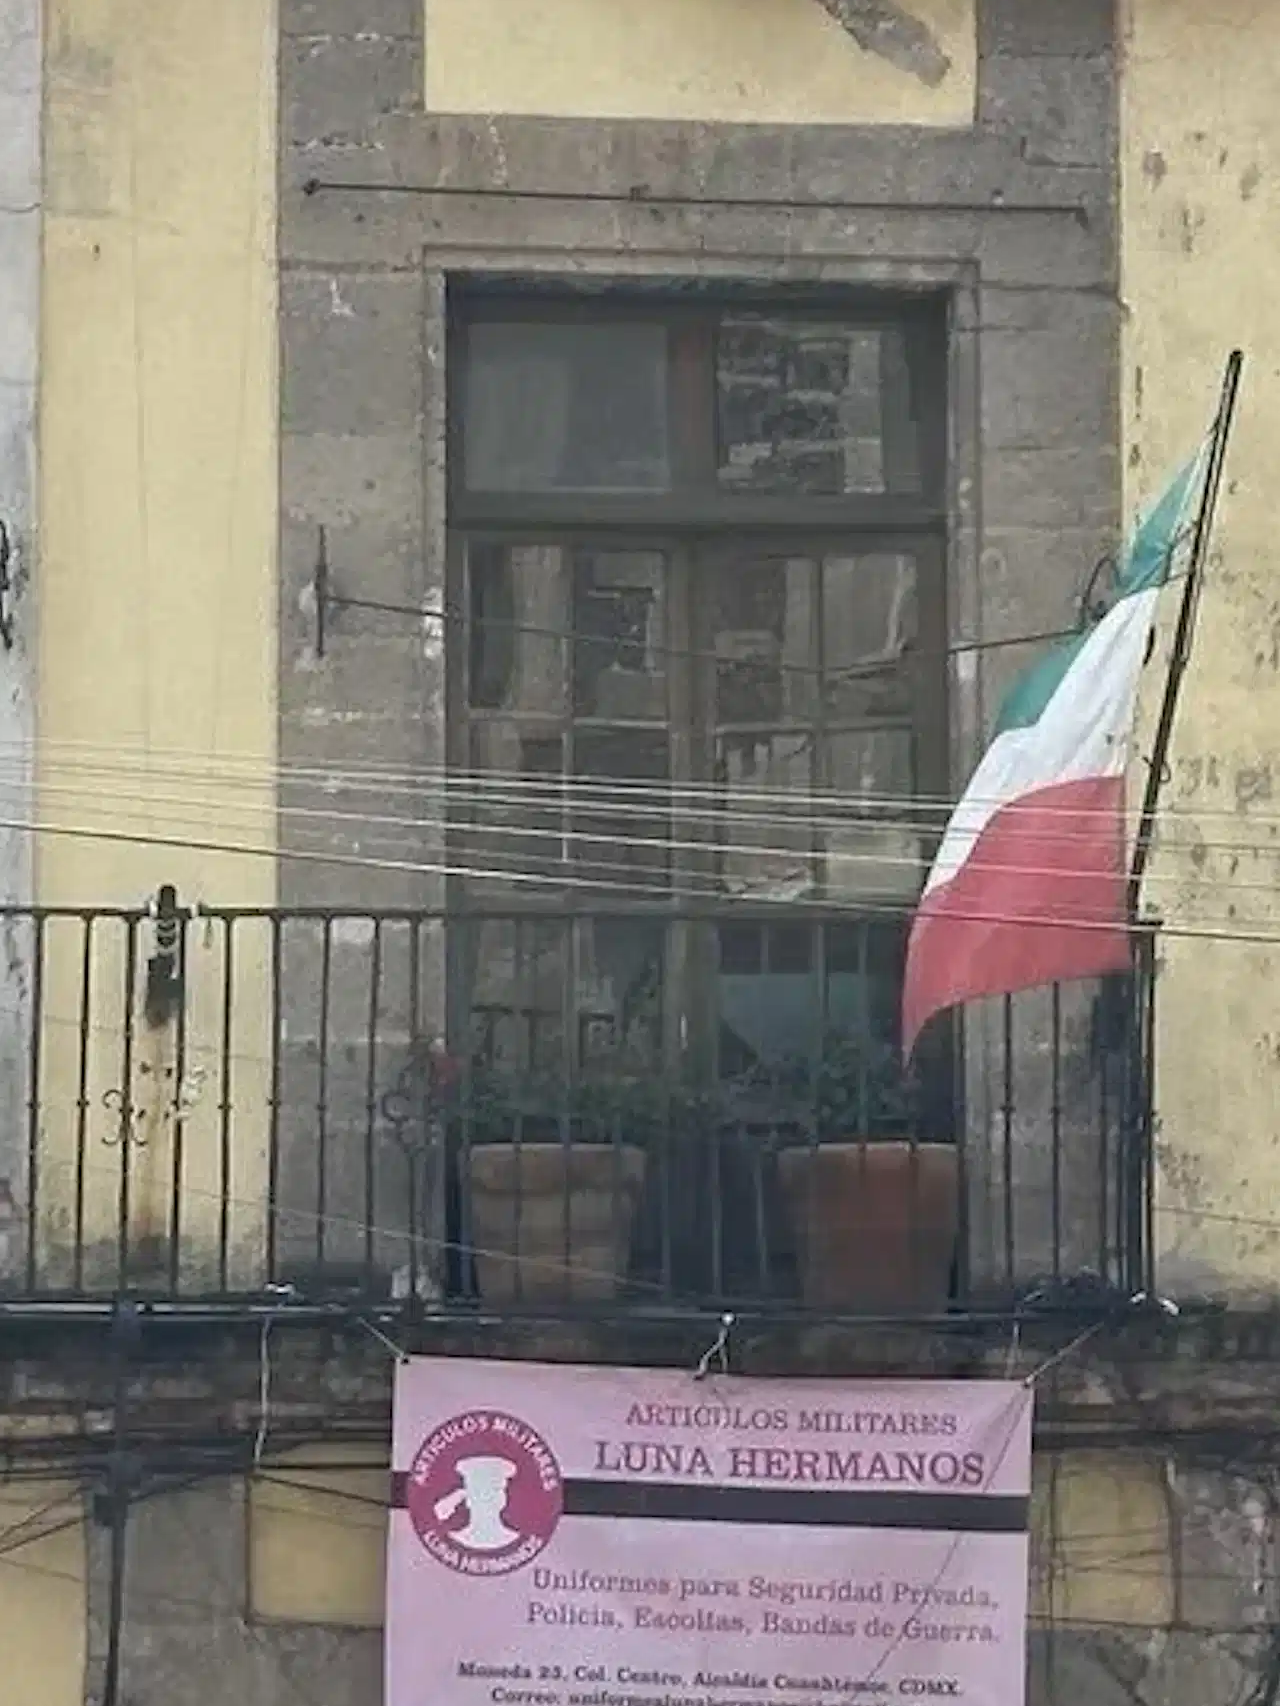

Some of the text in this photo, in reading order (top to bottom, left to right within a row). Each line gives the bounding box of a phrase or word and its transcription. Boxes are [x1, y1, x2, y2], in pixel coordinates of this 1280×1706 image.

[625, 1401, 958, 1437] ARTICULOS MILITARES
[594, 1441, 985, 1486] LUNA HERMANOS
[532, 1567, 672, 1595] Uniformes
[678, 1576, 740, 1602] para
[749, 1575, 884, 1606] Seguridad
[762, 1610, 857, 1638] Bandas
[864, 1614, 896, 1639] de
[457, 1661, 532, 1681] Moneda
